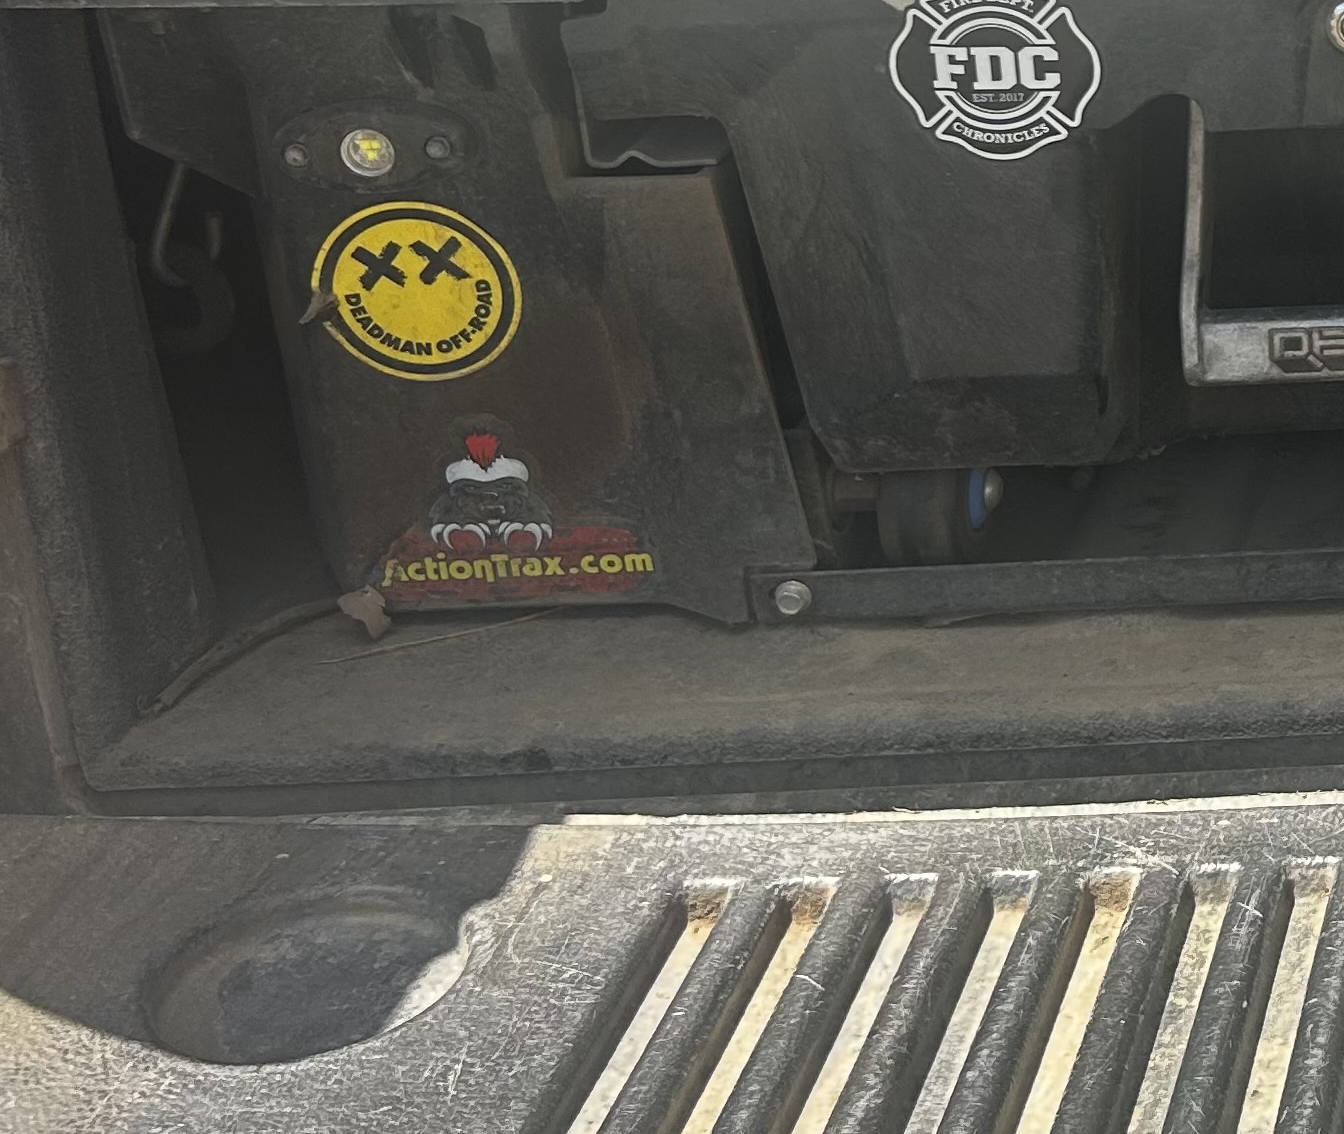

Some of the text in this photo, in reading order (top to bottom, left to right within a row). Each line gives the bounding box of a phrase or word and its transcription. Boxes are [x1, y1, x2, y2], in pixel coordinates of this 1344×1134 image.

[929, 46, 1061, 91] FDC
[971, 92, 1025, 104] EST. 2017
[952, 121, 1051, 144] CHRONICLES
[344, 278, 494, 357] DEADMAN OFF-ROAD
[381, 551, 655, 587] ActionTrax.com
